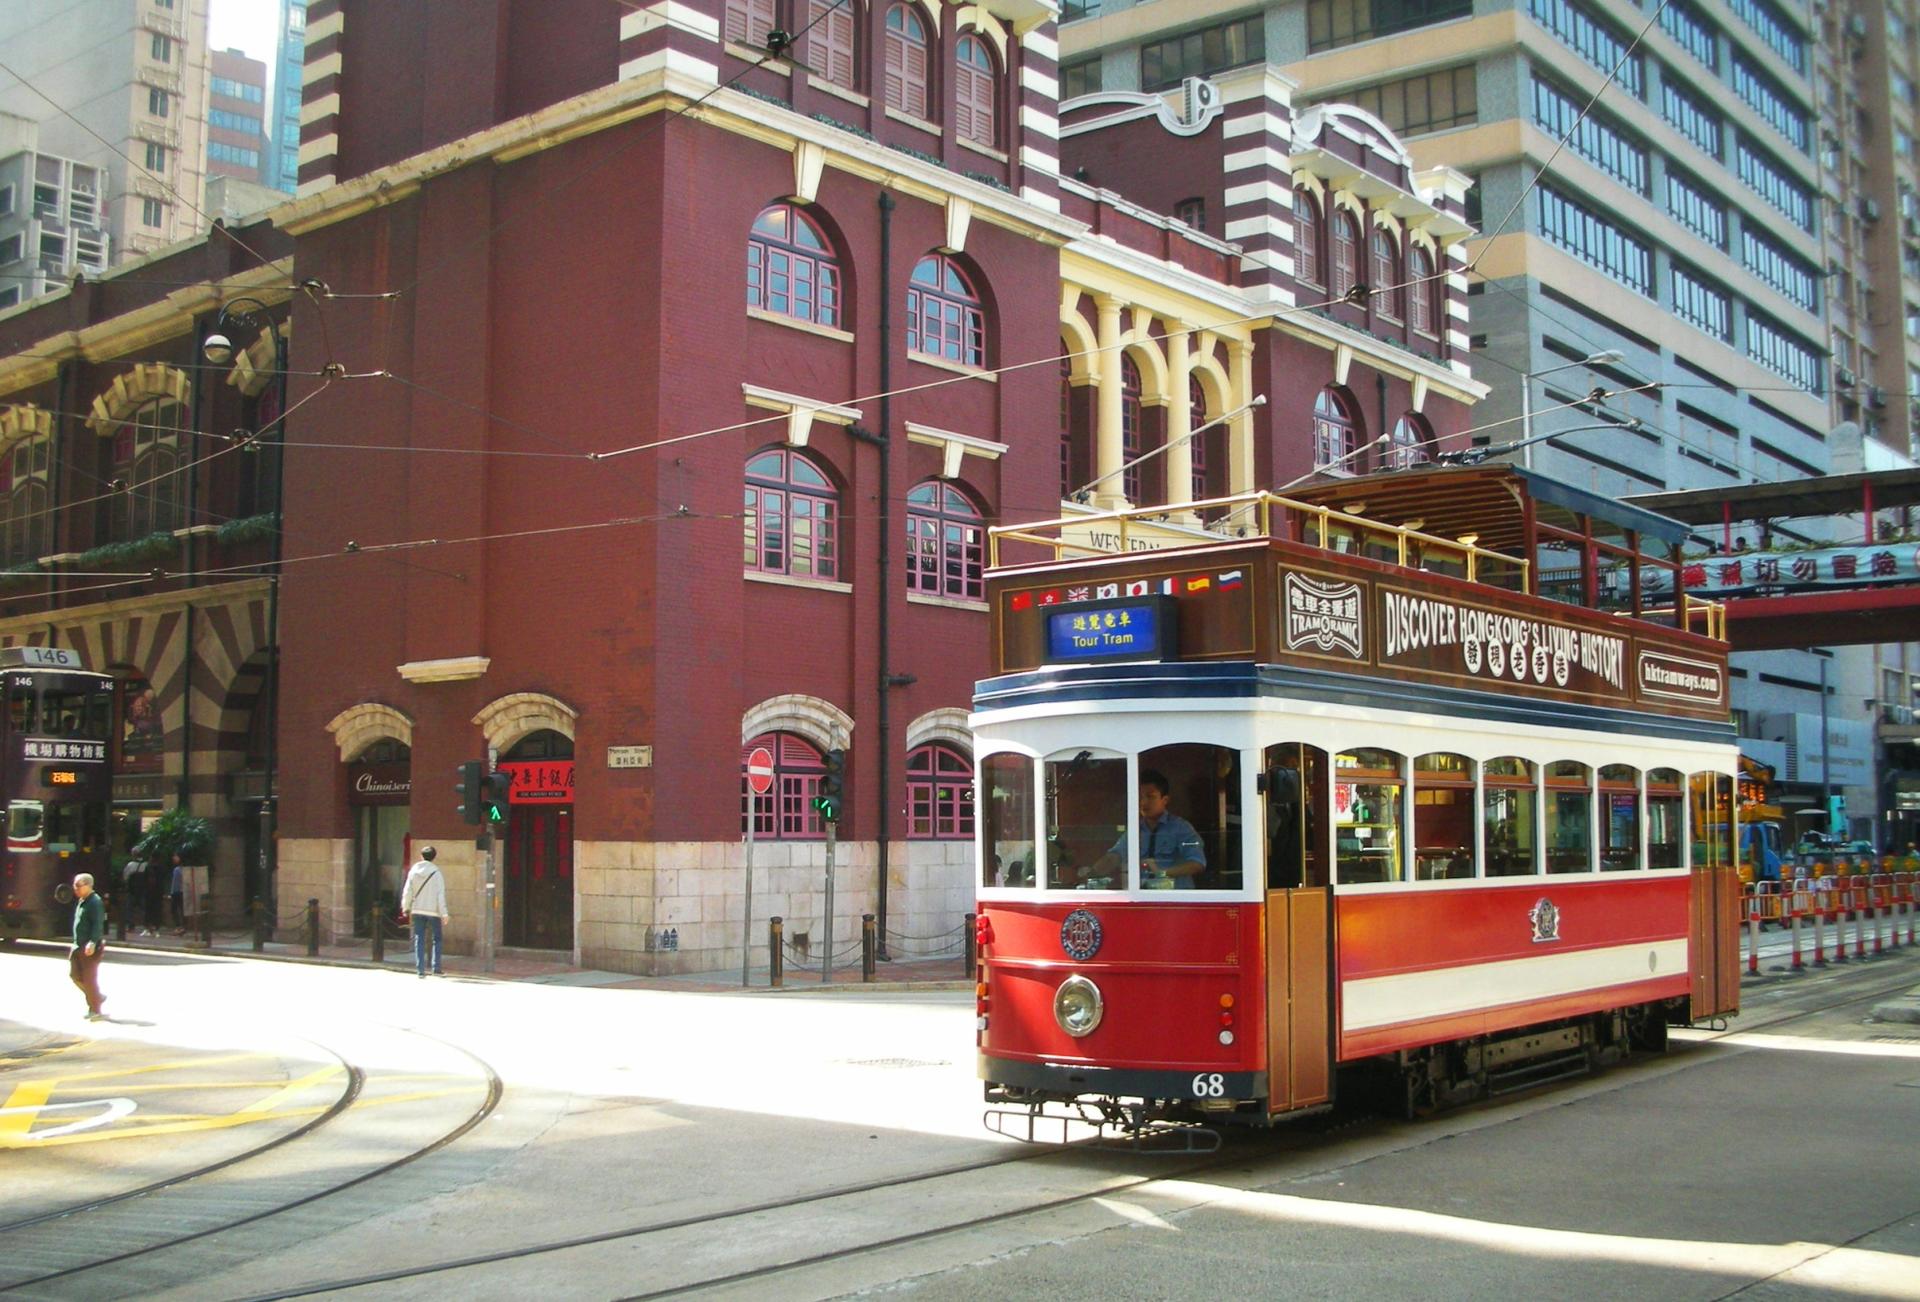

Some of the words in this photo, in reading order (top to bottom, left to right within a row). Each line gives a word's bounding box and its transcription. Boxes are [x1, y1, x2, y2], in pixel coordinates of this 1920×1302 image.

[1291, 613, 1358, 646] TRAMORAMIC
[1072, 634, 1099, 648] Tour
[1102, 633, 1133, 646] Tram
[1385, 591, 1457, 657] DISCOVER
[1541, 623, 1579, 664] LIVING
[1581, 632, 1623, 691] HISTORY
[34, 648, 69, 665] 146
[15, 676, 33, 687] 146
[100, 681, 114, 690] 146
[1644, 662, 1718, 692] hktramways.com
[1192, 1072, 1225, 1097] 68
